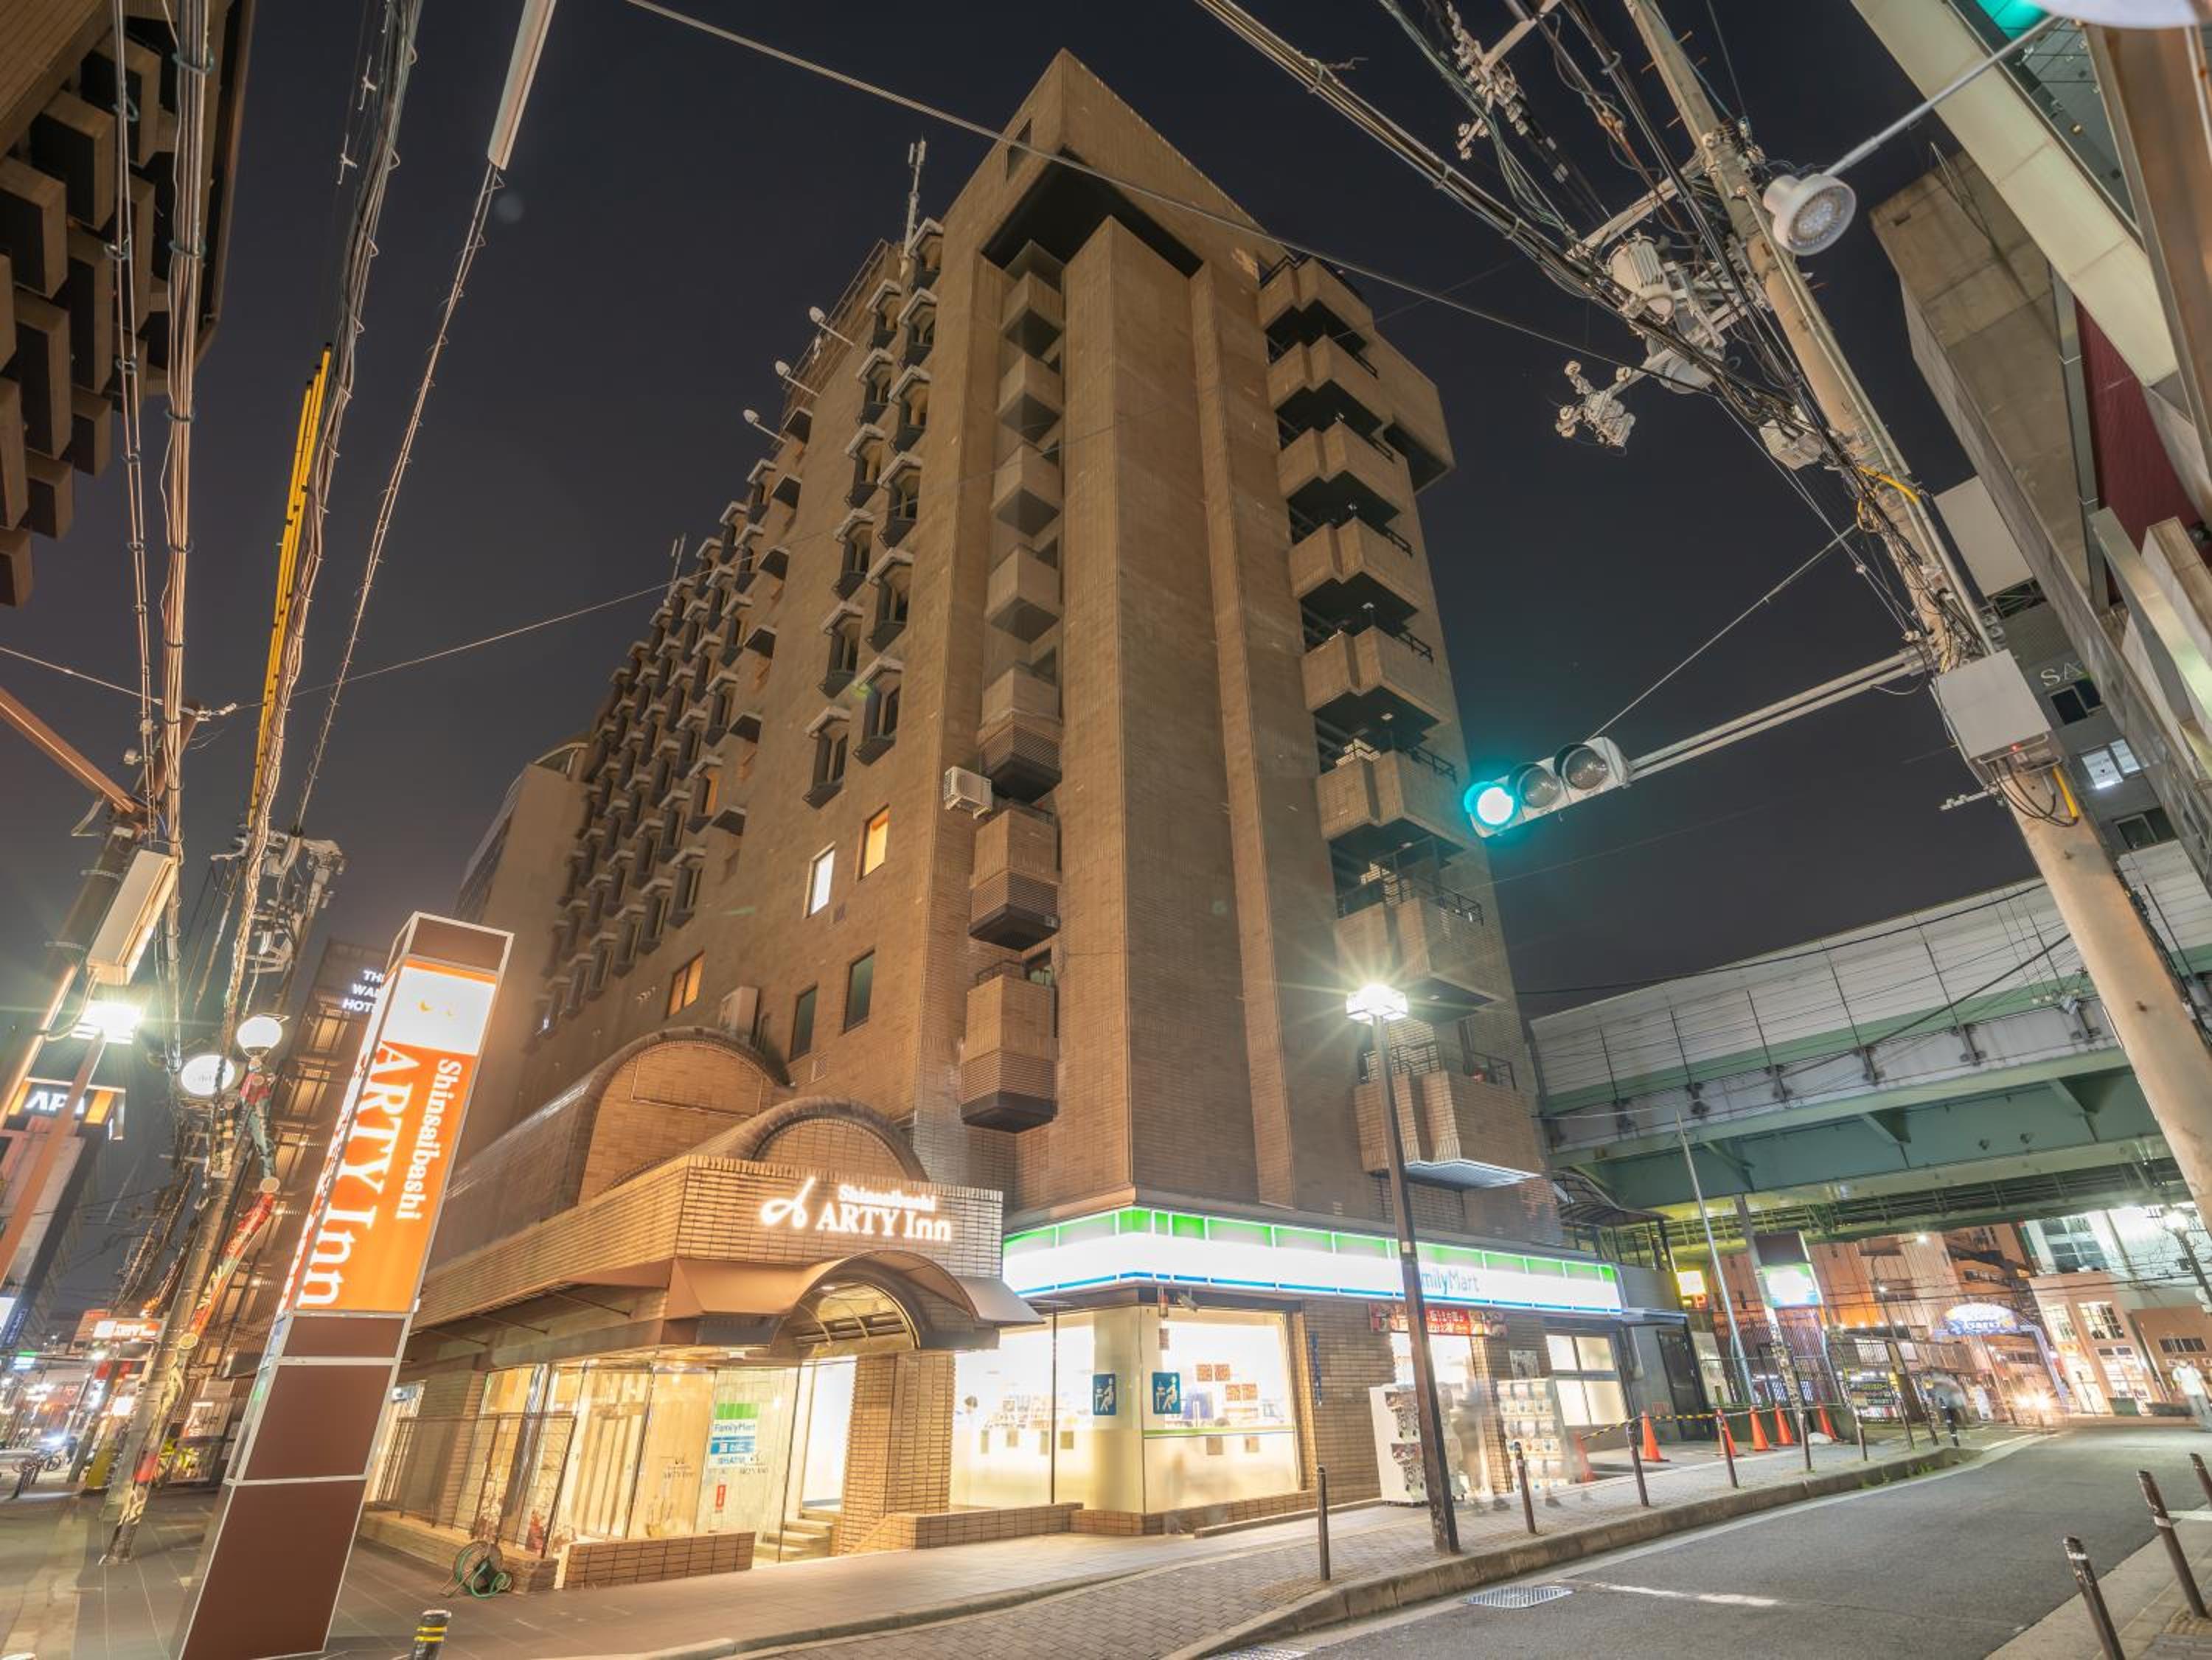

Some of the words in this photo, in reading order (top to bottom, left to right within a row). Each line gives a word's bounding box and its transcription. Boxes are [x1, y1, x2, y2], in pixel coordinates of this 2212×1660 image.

[352, 983, 378, 997] WA
[336, 1041, 421, 1194] ARTY
[395, 1059, 462, 1220] Shinsaibashi
[296, 1203, 378, 1308] Inn
[815, 1202, 901, 1236] ARTY
[903, 1211, 952, 1241] Inn
[1420, 1269, 1480, 1295] milyMart
